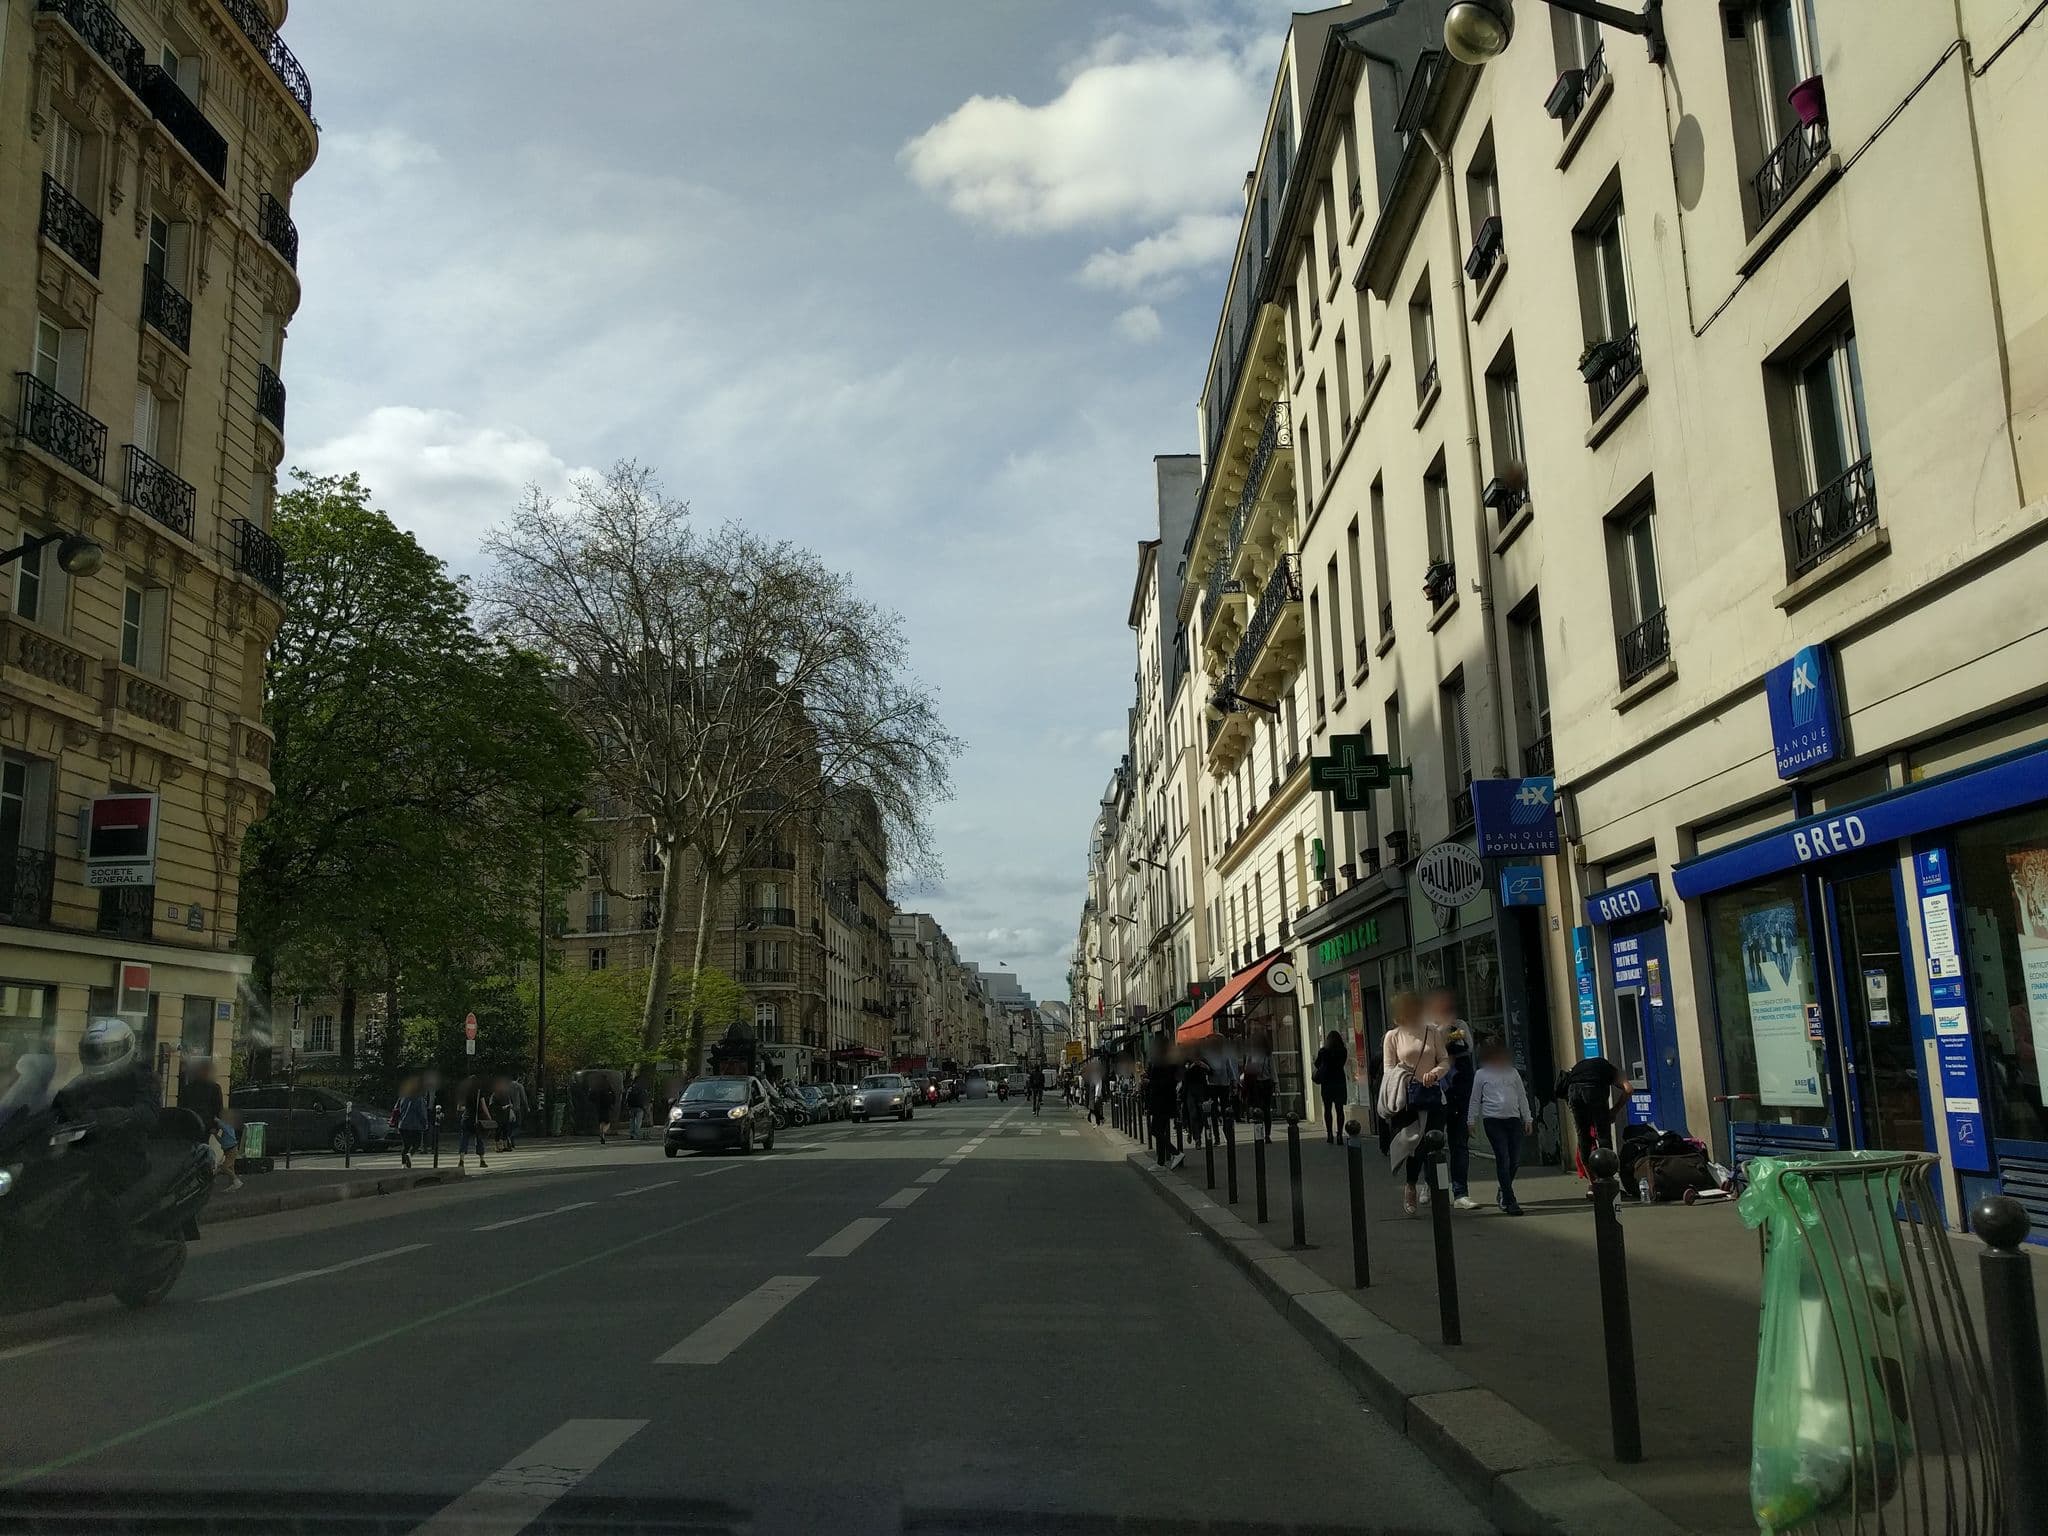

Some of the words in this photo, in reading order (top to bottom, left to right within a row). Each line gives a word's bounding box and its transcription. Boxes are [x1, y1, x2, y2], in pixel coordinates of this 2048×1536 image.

[1776, 727, 1826, 756] BANQUE
[1778, 742, 1829, 771] POPULAIRE
[1486, 831, 1554, 841] BANQUE
[1487, 841, 1556, 852] POPULAIRE
[1793, 816, 1866, 861] BRED
[91, 868, 133, 876] SOCIETE
[91, 875, 144, 884] GENERALE
[1421, 855, 1481, 895] PALLADIUM
[1600, 890, 1640, 920] BRED
